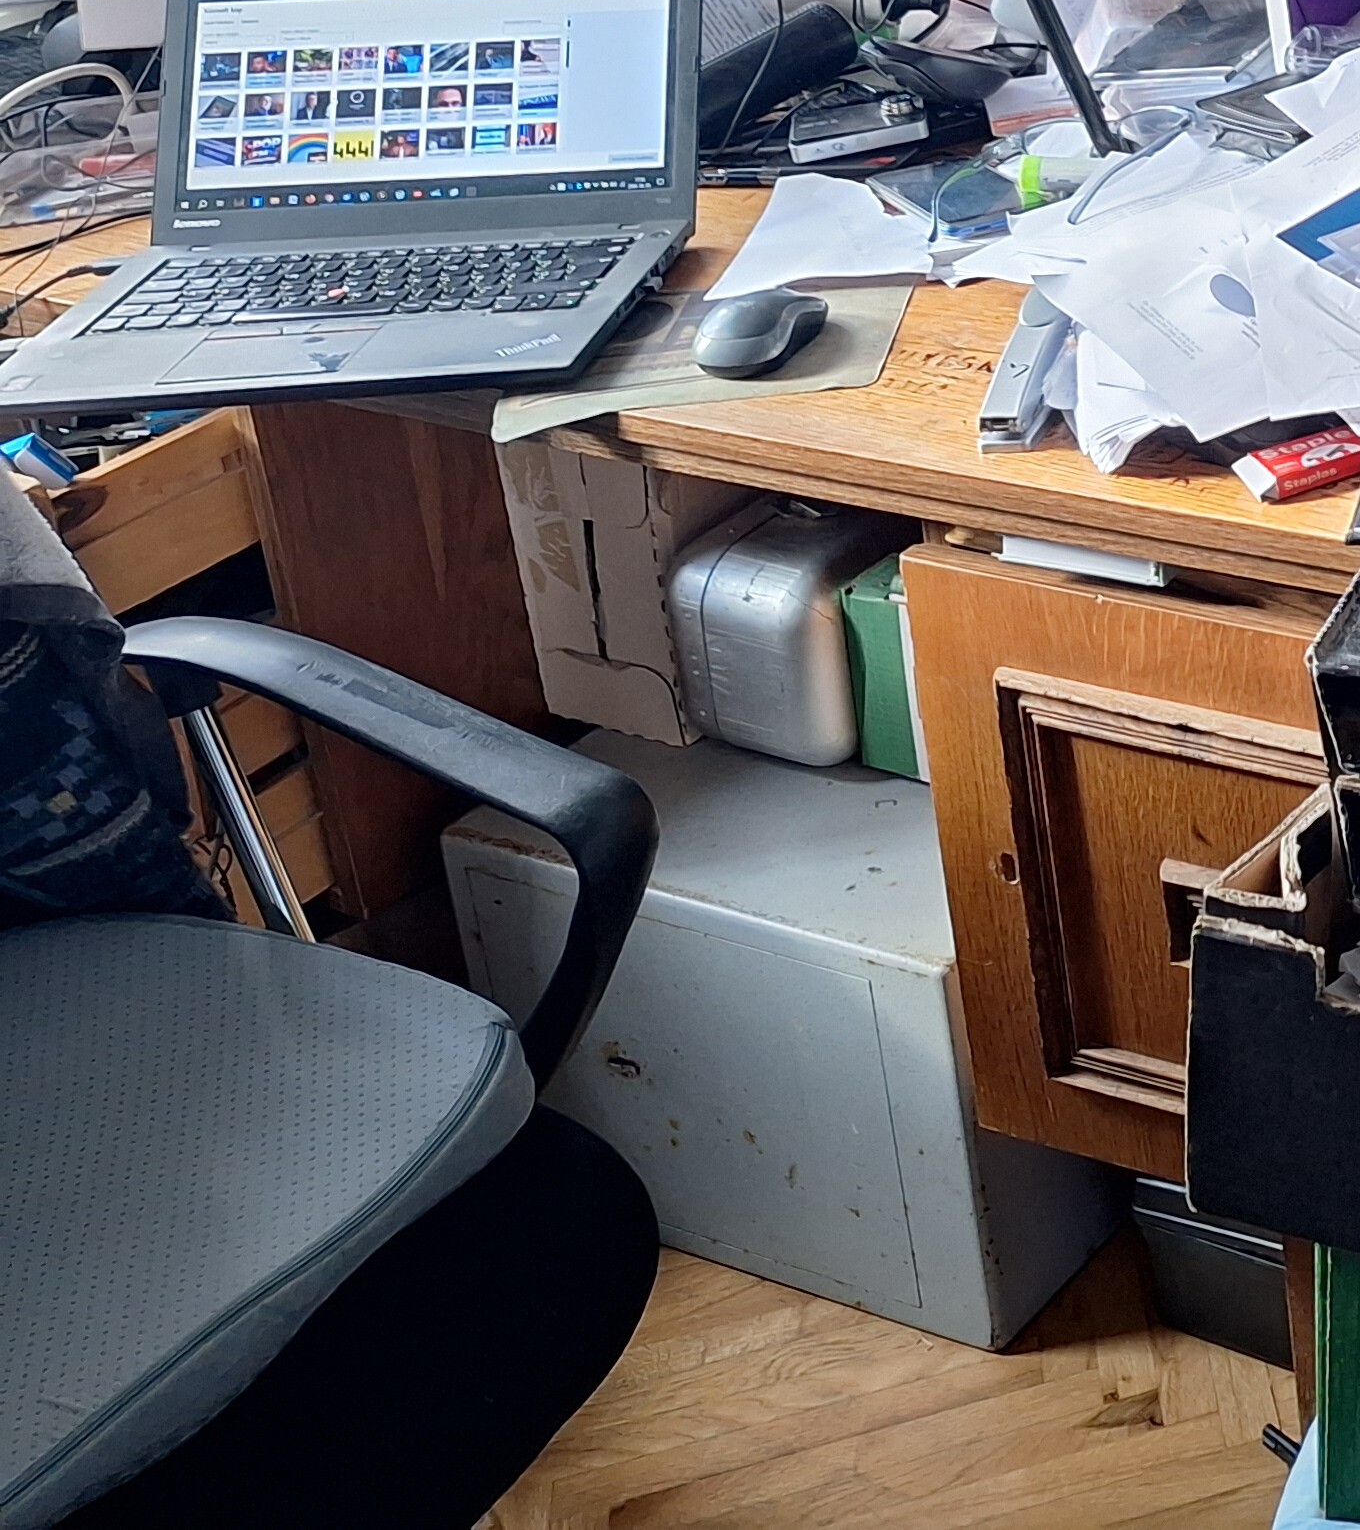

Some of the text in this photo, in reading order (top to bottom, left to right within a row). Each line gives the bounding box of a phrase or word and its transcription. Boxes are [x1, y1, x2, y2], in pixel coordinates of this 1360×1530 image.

[172, 217, 222, 230] lenovo
[494, 332, 562, 358] ThinkPad
[1258, 430, 1350, 460] Staple
[1283, 467, 1338, 491] Staples
